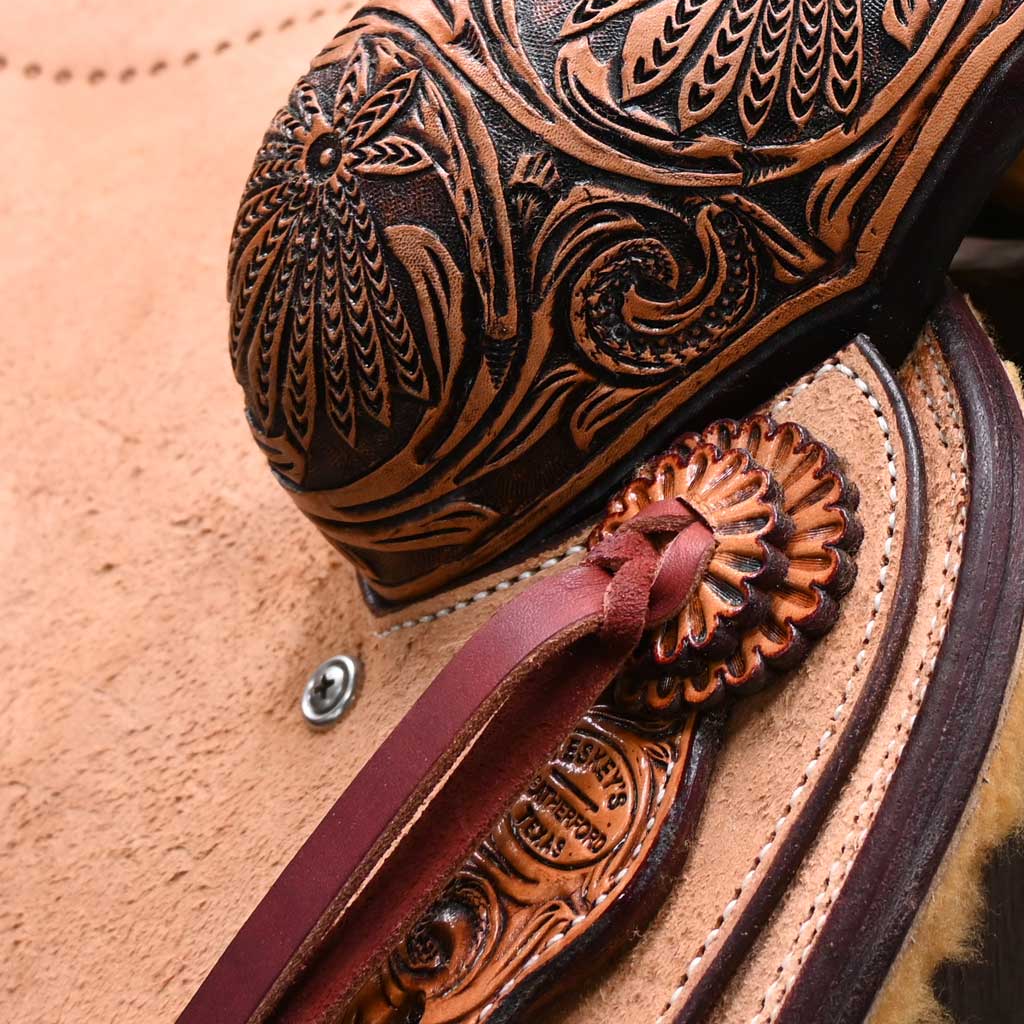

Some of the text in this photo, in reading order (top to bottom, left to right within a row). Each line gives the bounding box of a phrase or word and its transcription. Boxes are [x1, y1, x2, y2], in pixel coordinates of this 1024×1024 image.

[561, 737, 628, 811] ESKEY'S
[518, 802, 566, 858] TEXAS
[527, 776, 608, 854] EATHERFORD
